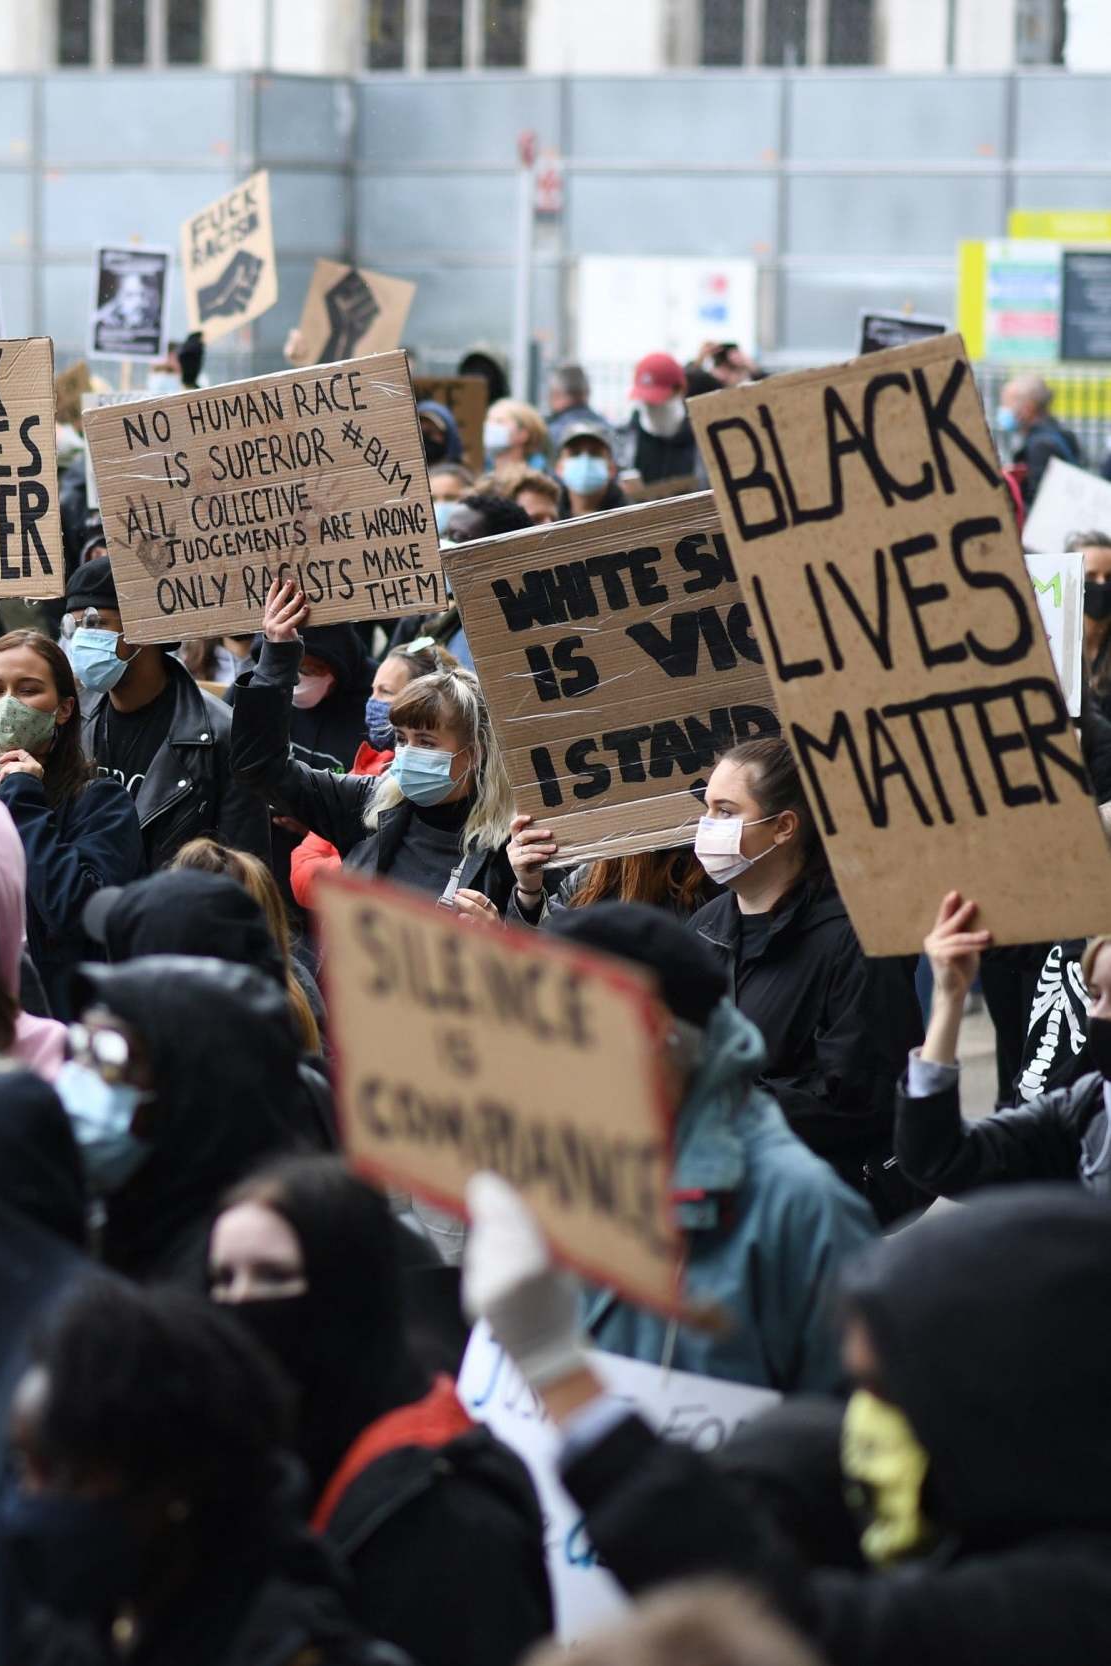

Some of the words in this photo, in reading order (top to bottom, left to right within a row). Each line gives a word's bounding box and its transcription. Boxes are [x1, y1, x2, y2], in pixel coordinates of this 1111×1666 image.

[122, 410, 171, 450] NO
[187, 383, 284, 435] HUMAN
[292, 371, 367, 417] RACE
[164, 450, 191, 489] IS
[208, 427, 335, 482] SUPERIOR
[340, 418, 412, 496] #BLM
[707, 359, 1001, 541] BLACK
[127, 500, 177, 545] ALL
[191, 483, 313, 532] COLLECTIVE
[165, 519, 308, 569] JUDGEMENTS
[319, 511, 357, 545] ARE
[362, 502, 428, 540] WRONG
[156, 573, 227, 615] ONLY
[362, 543, 425, 578] MAKE
[364, 573, 439, 611] THEM
[491, 546, 669, 632] WHITE
[751, 516, 1034, 682] LIVES
[525, 636, 599, 701] IS
[531, 747, 563, 807] I
[564, 705, 781, 799] STAND
[791, 677, 1091, 836] MATTER
[355, 906, 598, 1048] SILENCE
